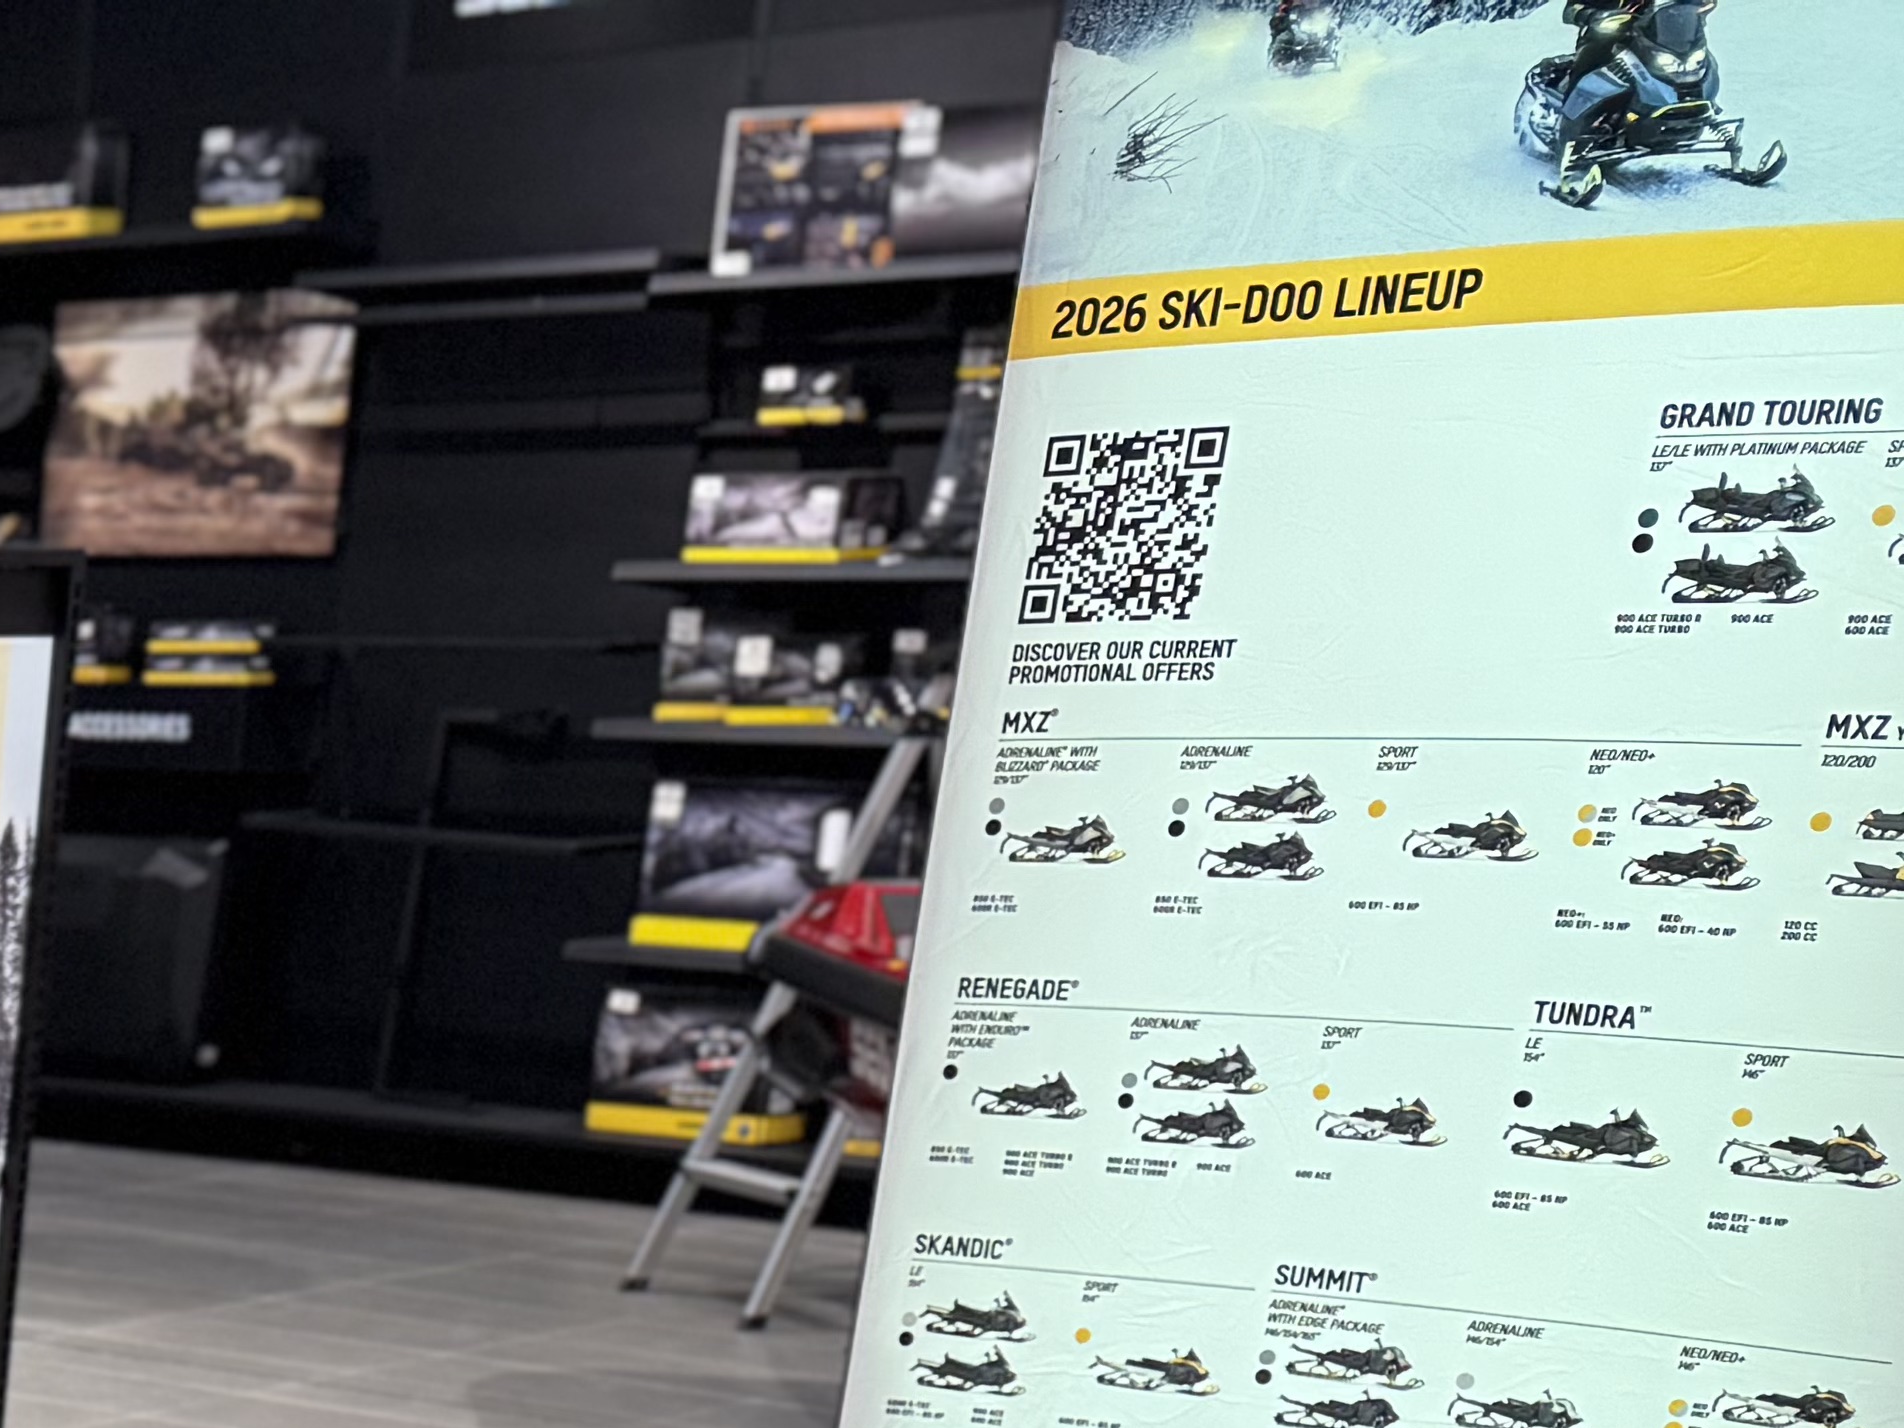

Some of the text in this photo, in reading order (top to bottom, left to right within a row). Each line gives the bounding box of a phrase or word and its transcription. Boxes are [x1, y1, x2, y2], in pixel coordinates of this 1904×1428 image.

[1052, 268, 1484, 339] 2026 SKI-DOO LINEUP
[1660, 397, 1884, 429] GRAND TOURING
[1652, 440, 1867, 458] LE/LE WITH PLATINUM PACKAGE
[1752, 614, 1774, 623] ACE
[1870, 615, 1893, 624] ACE
[1868, 626, 1890, 635] ACE
[1012, 638, 1238, 663] DISCOVER OUR CURRENT
[1008, 662, 1216, 685] PROMOTIONAL OFFERS
[1825, 714, 1892, 741] MXZ
[1070, 745, 1099, 758] WITH
[1180, 745, 1253, 758] ADRENALINE
[1378, 746, 1419, 759] SPORT
[1589, 749, 1656, 762] NEO/NEO+
[1050, 759, 1101, 772] PACKAGE
[1821, 754, 1876, 769] 120/200
[951, 1010, 1018, 1023] ADRENALINE
[950, 1023, 978, 1035] WITH
[1130, 1016, 1201, 1032] ADRENALINE
[1322, 1026, 1363, 1040] SPORT
[948, 1036, 997, 1049] PACKAGE
[1525, 1037, 1543, 1050] LE
[1744, 1053, 1790, 1068] SPORT
[1083, 1280, 1119, 1294] SPORT
[1267, 1313, 1385, 1335] WITH EDGE PACKAGE
[1467, 1320, 1545, 1339] ADRENALINE
